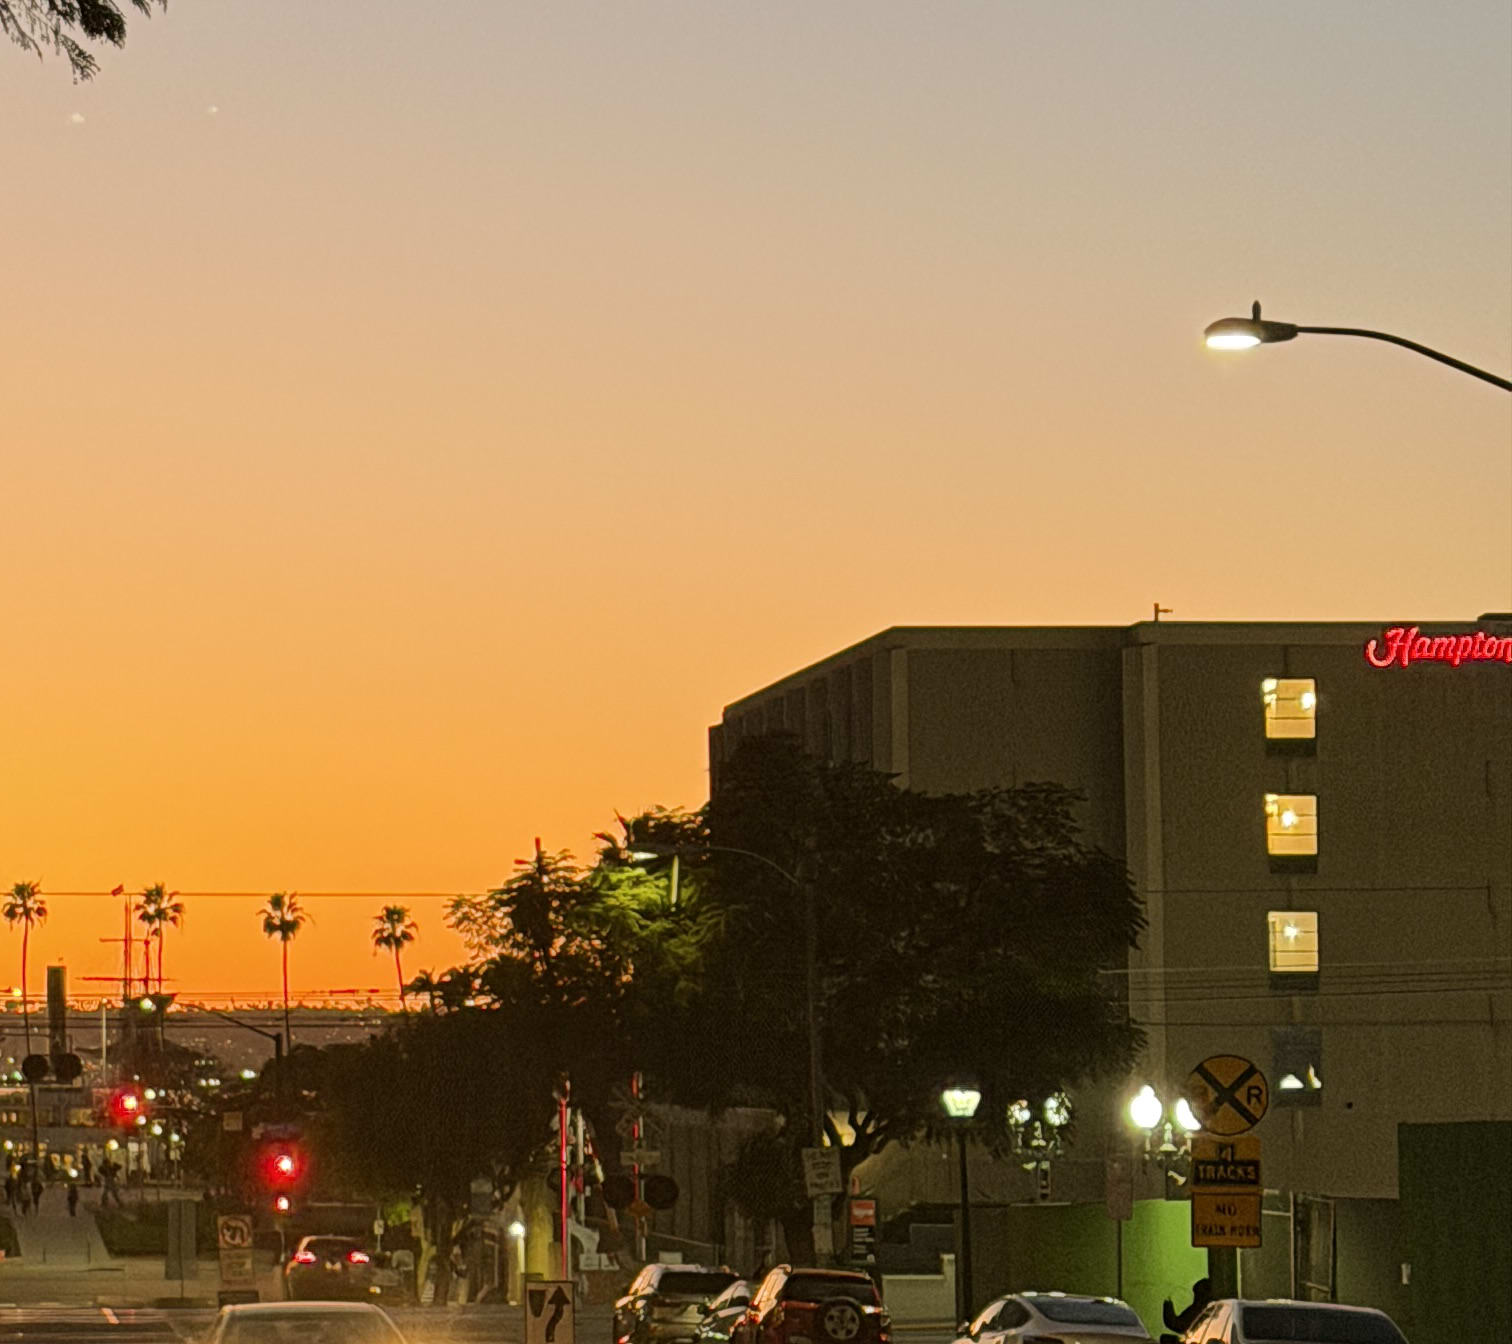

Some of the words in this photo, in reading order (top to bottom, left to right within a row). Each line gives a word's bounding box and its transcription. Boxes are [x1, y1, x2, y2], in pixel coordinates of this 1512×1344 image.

[1367, 626, 1512, 667] Hampton
[1246, 1085, 1263, 1105] R
[1198, 1165, 1256, 1179] TRACKS
[1215, 1205, 1237, 1217] NO
